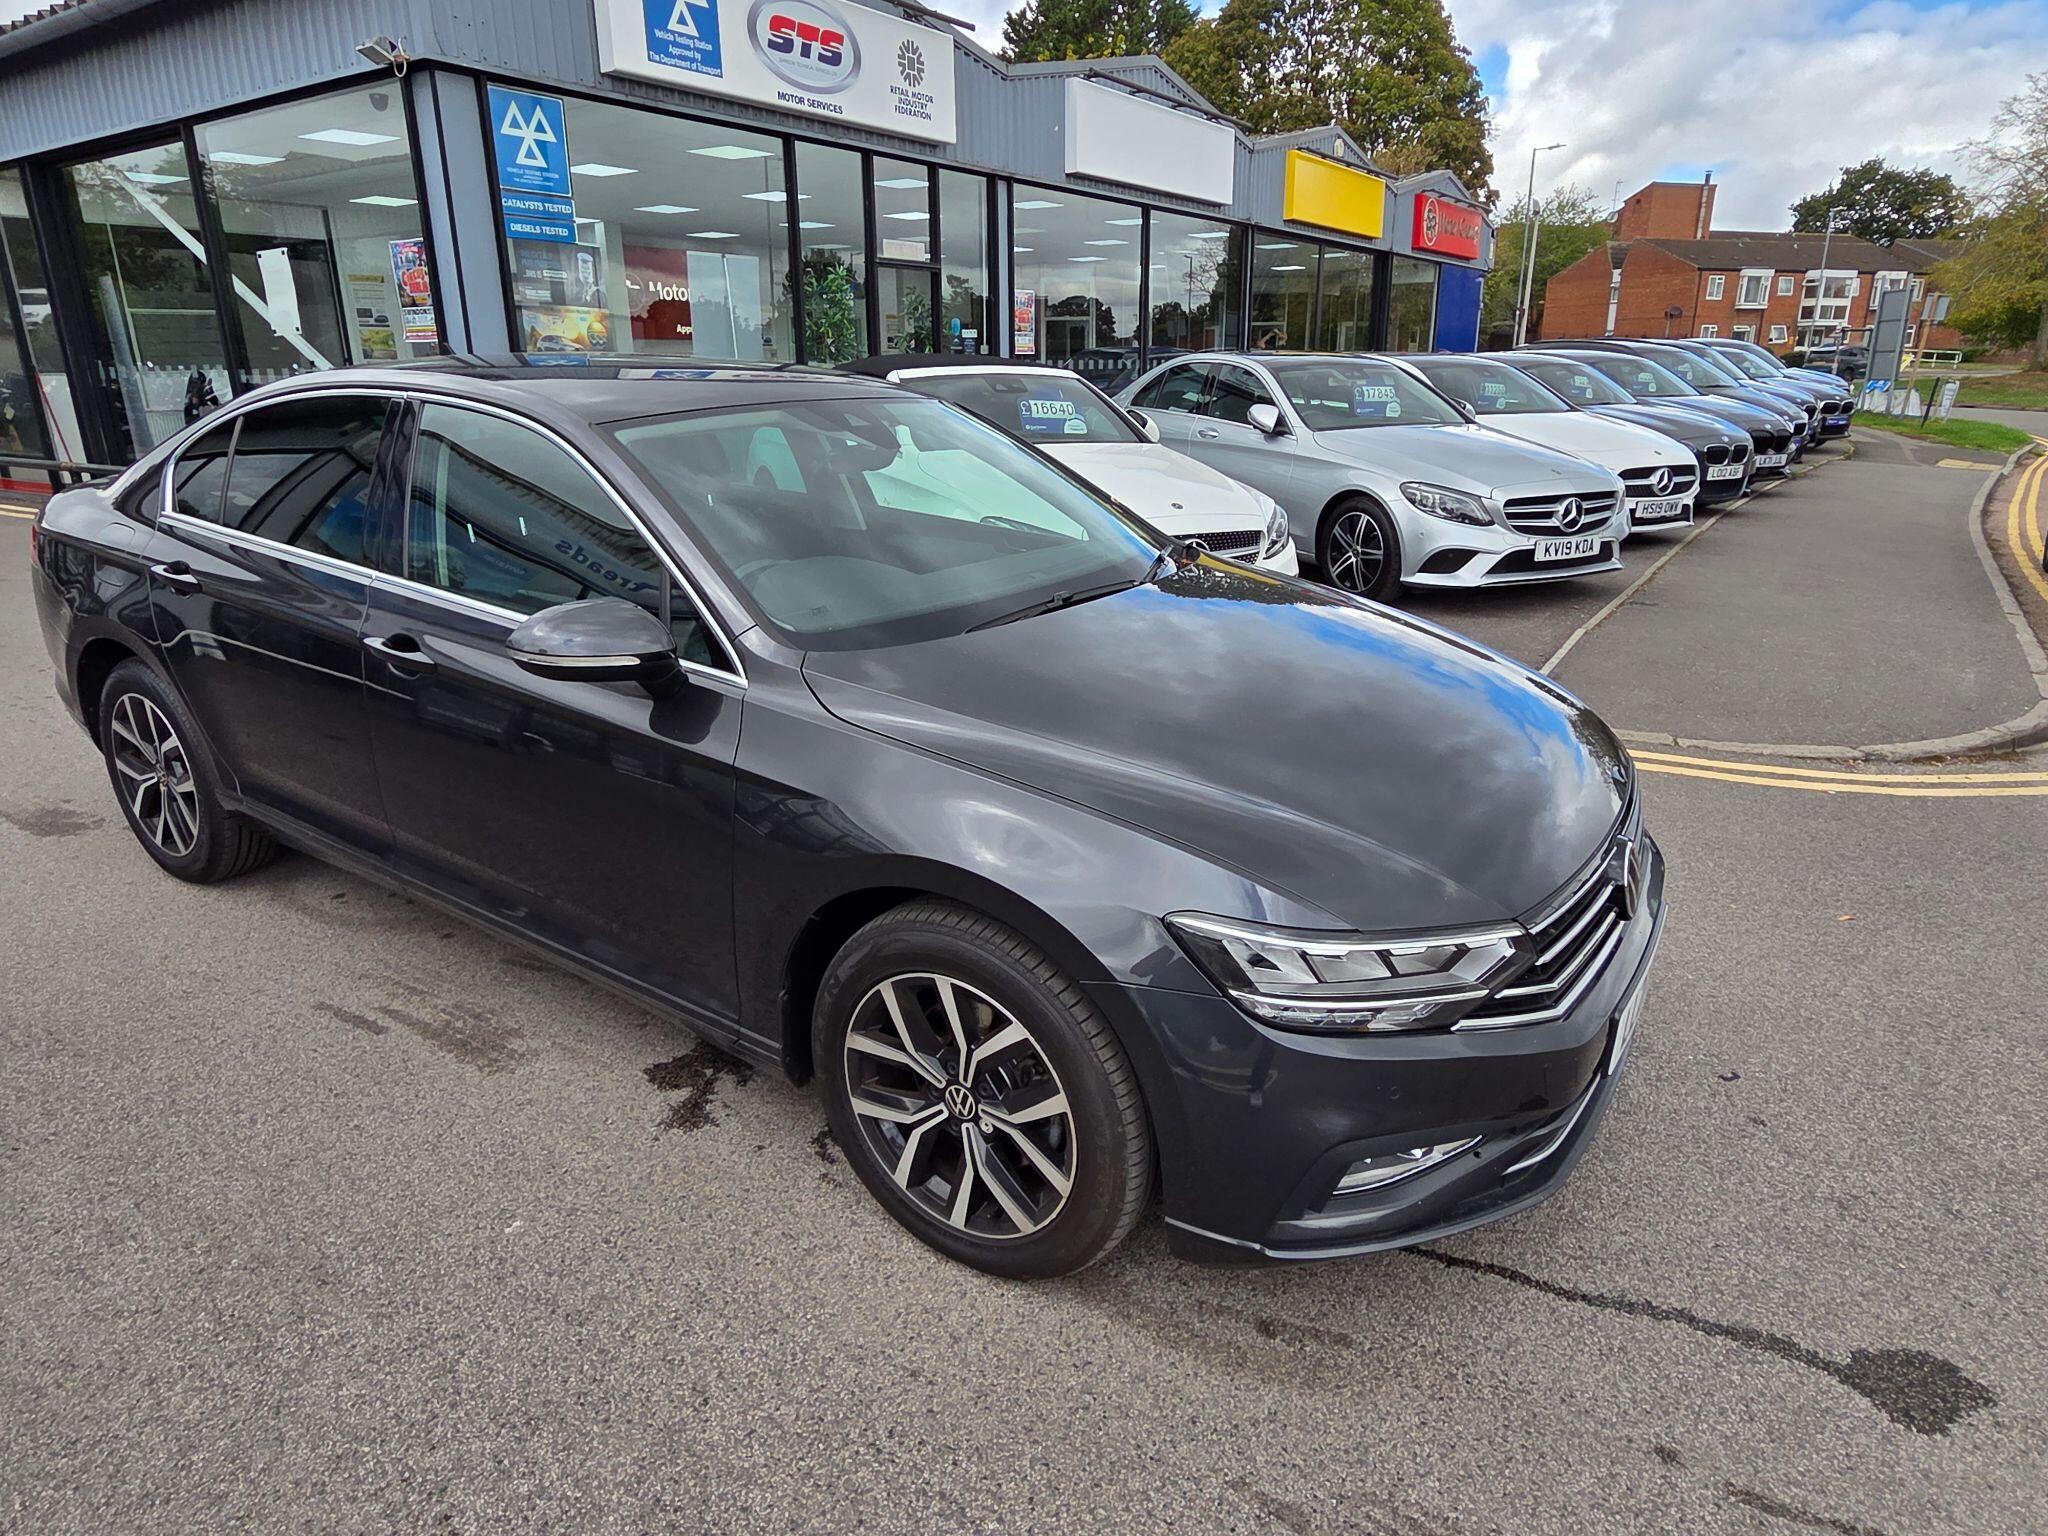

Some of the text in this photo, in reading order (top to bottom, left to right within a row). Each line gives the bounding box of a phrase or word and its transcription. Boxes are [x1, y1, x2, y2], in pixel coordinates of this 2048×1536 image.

[654, 28, 713, 51] Vehicle Testing Station
[767, 14, 845, 67] STS
[649, 50, 660, 61] The
[660, 53, 691, 69] Department
[668, 44, 694, 58] Approved
[777, 91, 844, 115] MOTOR SERVICES
[890, 85, 934, 104] RETAIL MOTOR
[897, 96, 928, 110] INDUSTRY
[894, 104, 932, 121] FEDERATION
[502, 198, 572, 214] CATALYSTS TESTED
[510, 222, 569, 237] DIESELS TESTED
[1642, 502, 1664, 515] HS19
[1544, 538, 1594, 558] KV19 KDA
